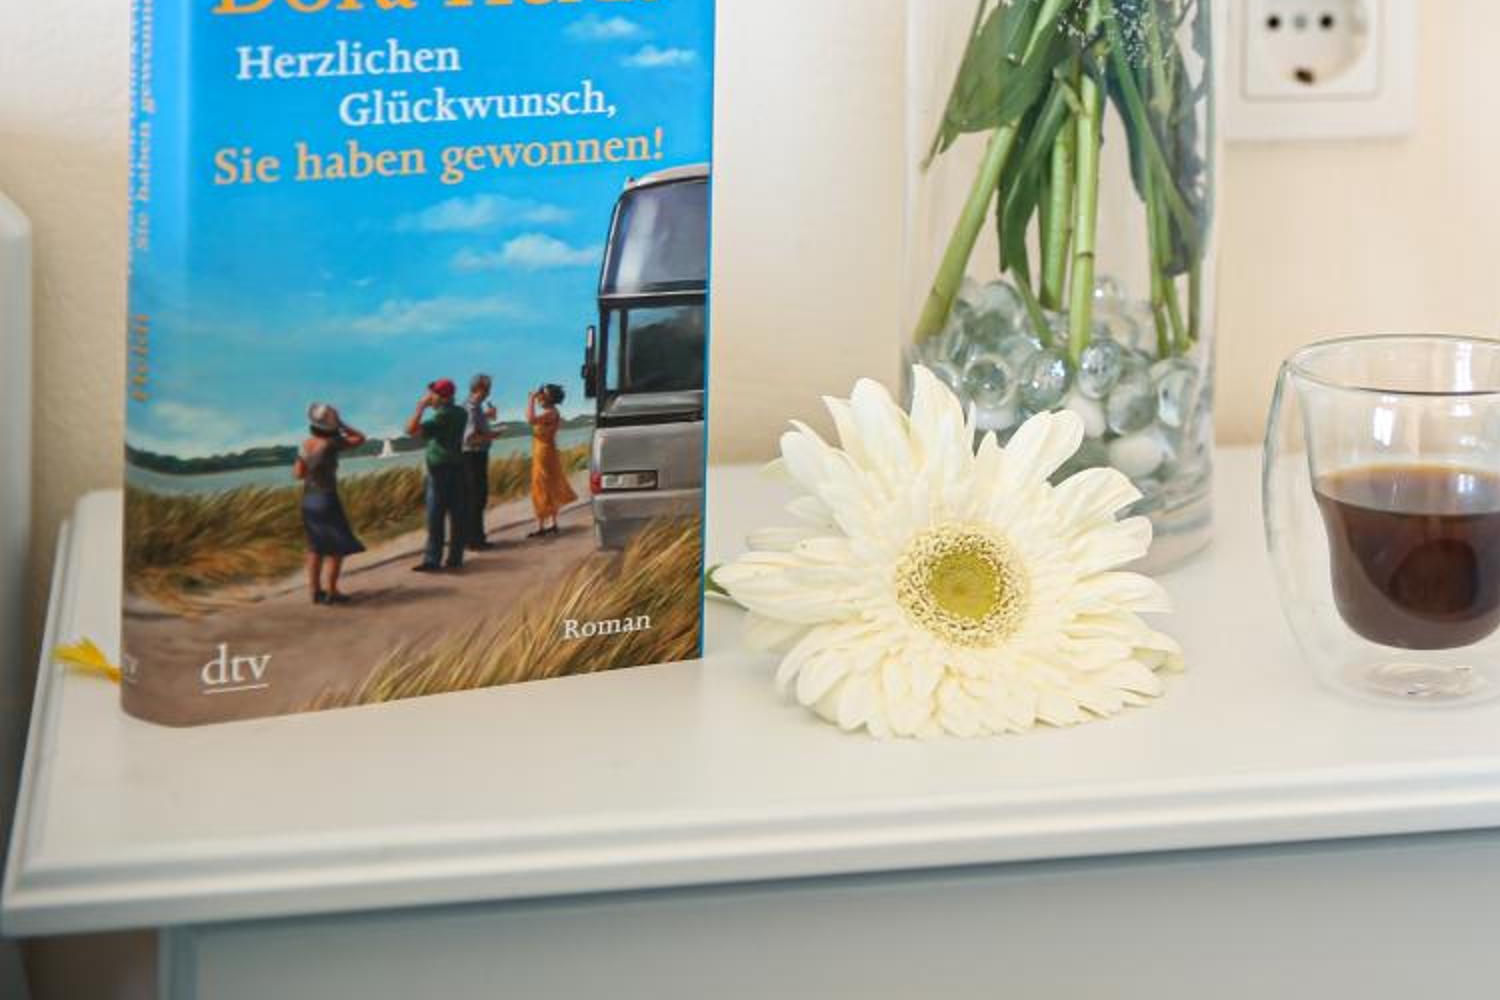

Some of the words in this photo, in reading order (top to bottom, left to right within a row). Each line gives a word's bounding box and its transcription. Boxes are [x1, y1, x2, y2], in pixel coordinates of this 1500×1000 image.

[236, 38, 461, 80] Herzlichen
[338, 80, 617, 127] Glückwunsch,
[213, 147, 281, 185] Sie
[296, 140, 427, 181] haben
[440, 127, 665, 183] gewonnen!
[564, 614, 652, 639] Roman
[201, 642, 272, 686] dtv
